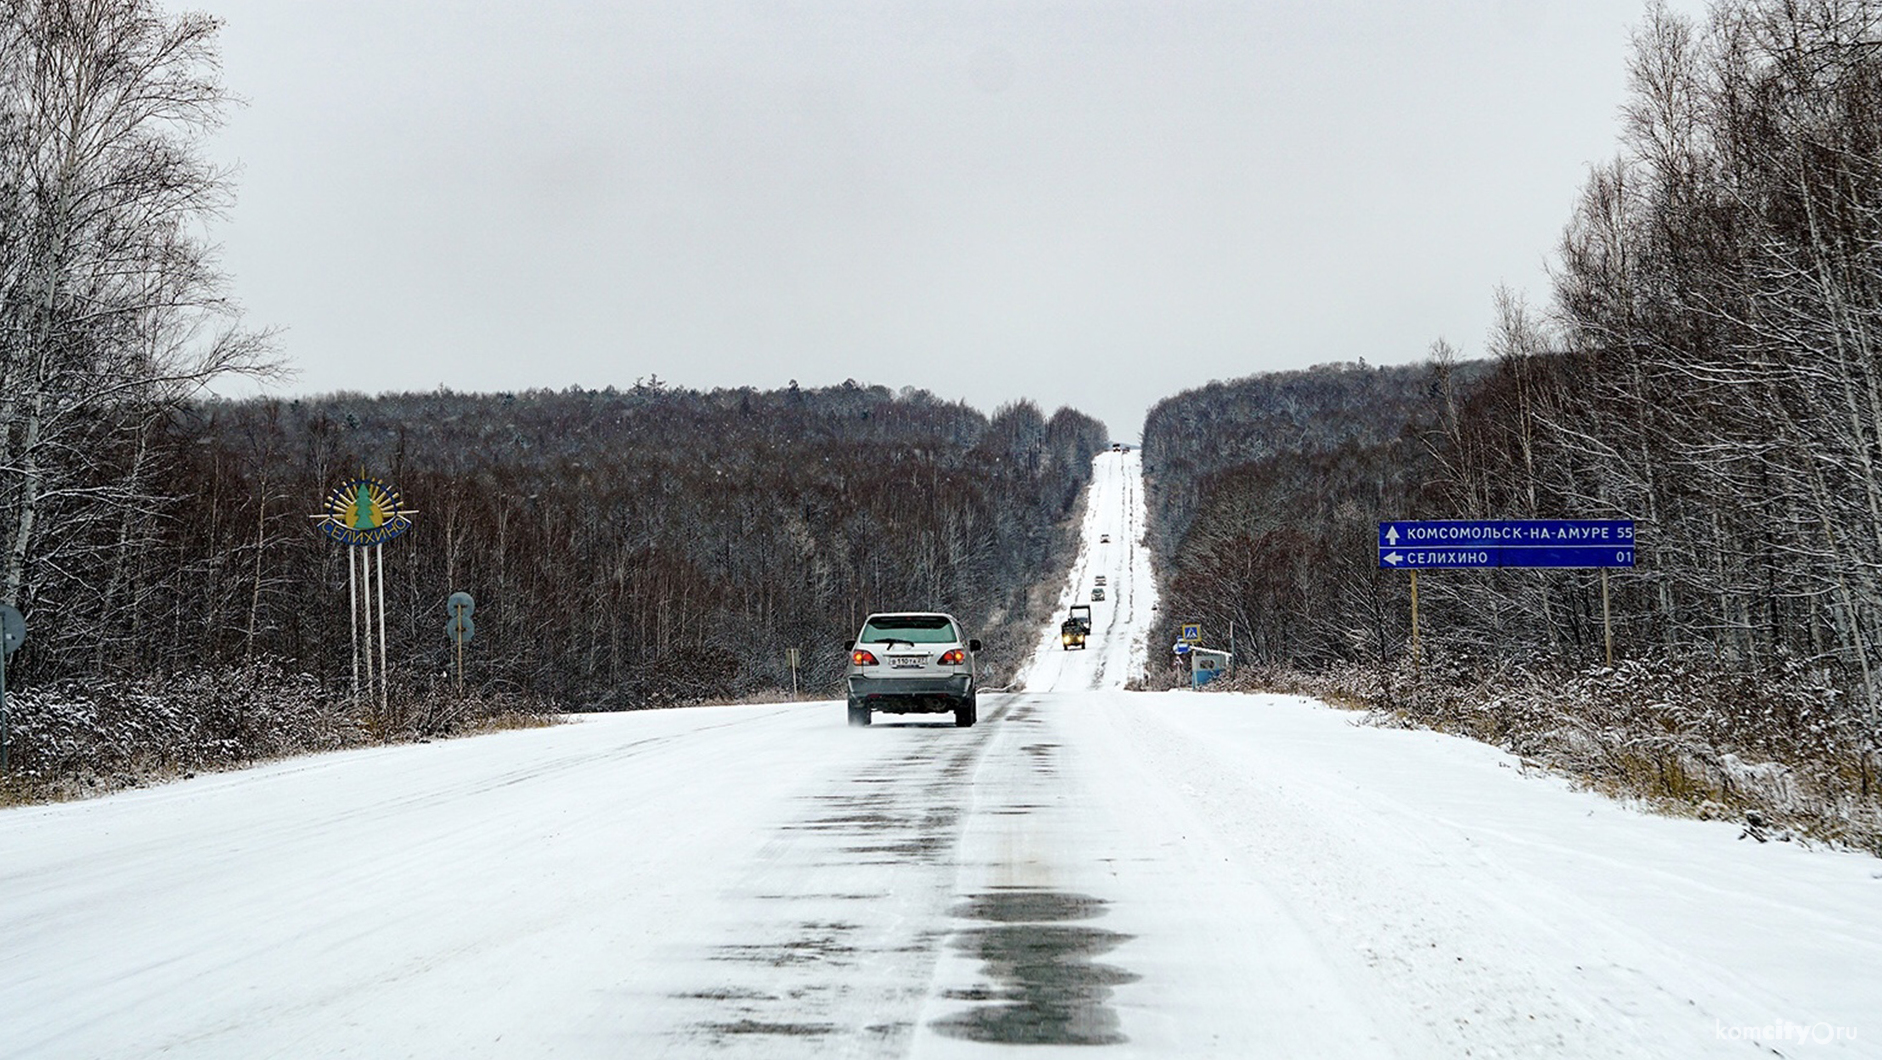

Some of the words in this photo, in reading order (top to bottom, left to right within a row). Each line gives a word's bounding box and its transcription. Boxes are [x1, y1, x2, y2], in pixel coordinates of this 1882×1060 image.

[321, 518, 406, 543] СЕЛИХИНО
[1407, 527, 1609, 540] КОМСОМОЛЬСК-НА-АМУРЕ
[1617, 527, 1633, 539] 55
[1407, 552, 1488, 564] СЕЛИХИНО
[1616, 551, 1632, 563] 01
